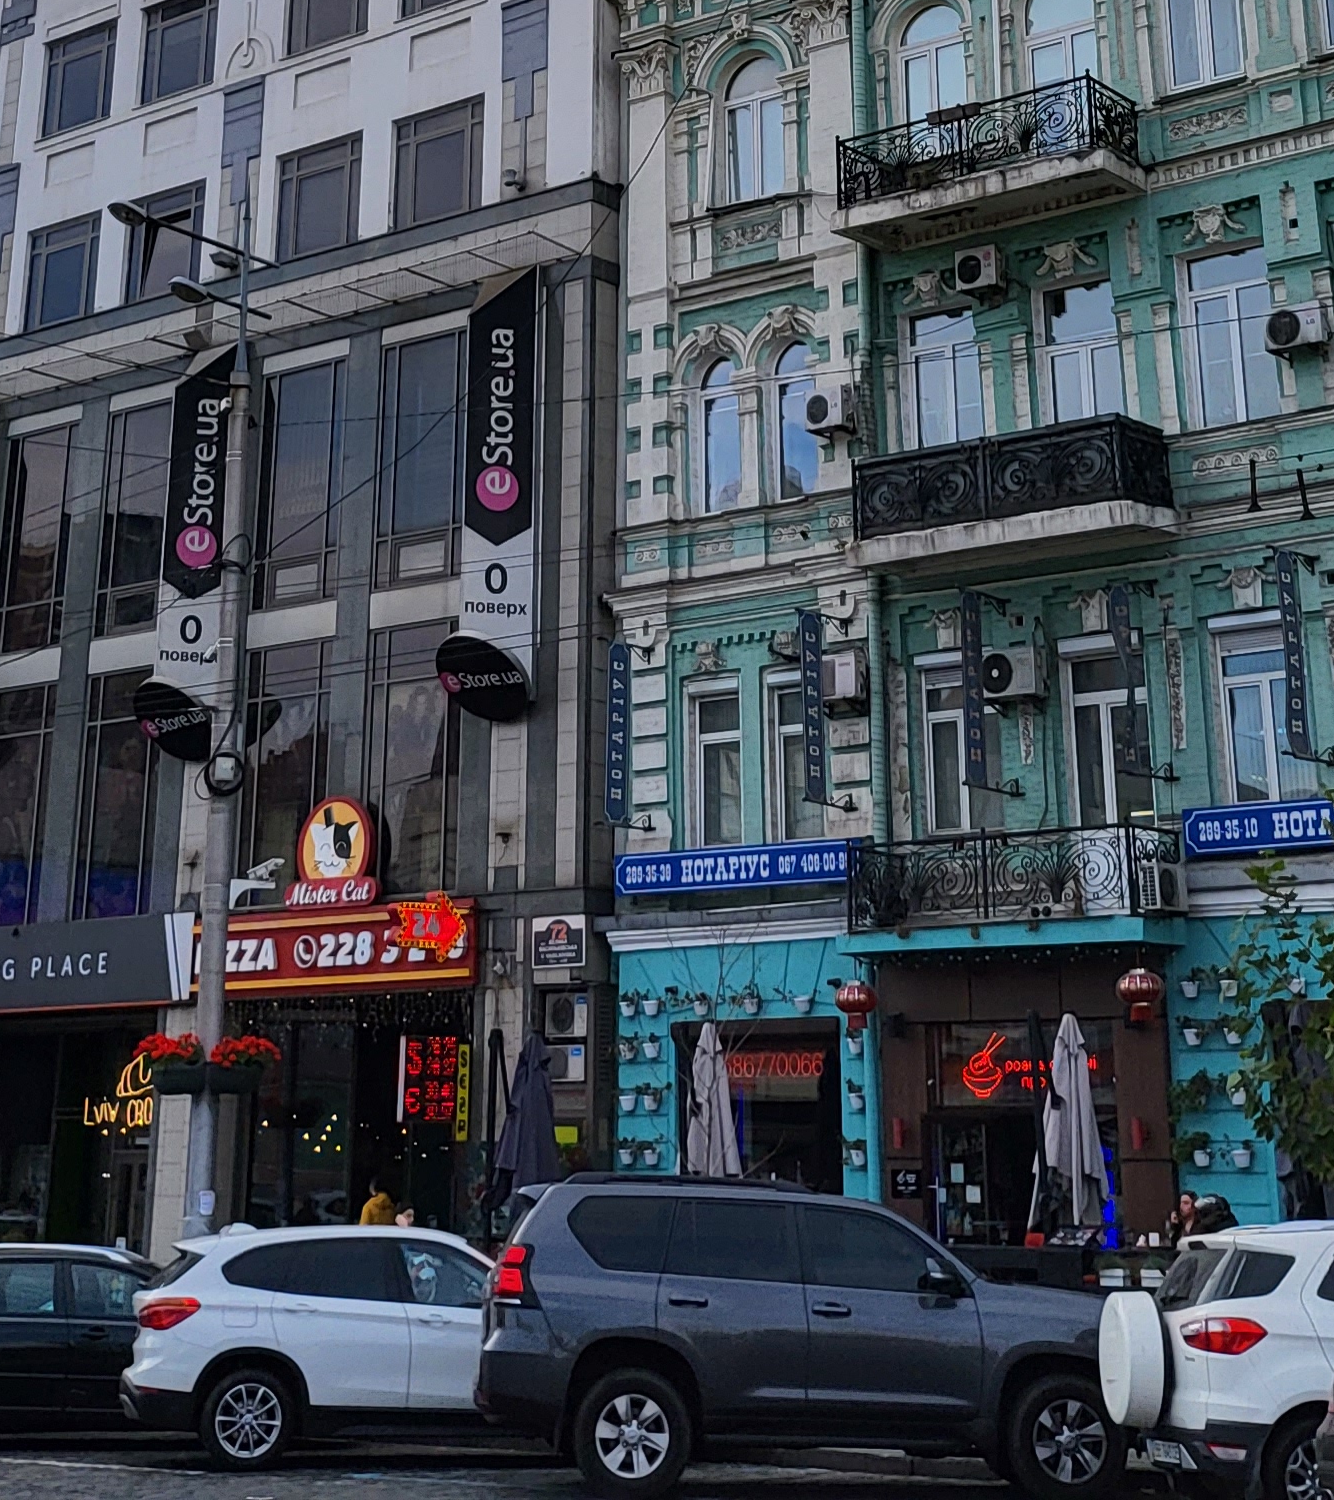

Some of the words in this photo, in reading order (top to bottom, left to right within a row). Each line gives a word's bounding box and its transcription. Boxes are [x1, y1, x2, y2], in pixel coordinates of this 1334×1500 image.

[482, 328, 515, 495] eStore.ua
[183, 398, 220, 552] eStore.ua
[465, 599, 528, 617] поверх
[1280, 570, 1304, 735] НОТАРІУС
[446, 670, 525, 692] eStore.ua
[805, 631, 821, 778] НОТАРІУС
[147, 708, 208, 736] eStore.ua
[610, 661, 625, 800] НОТАРІУС
[1198, 816, 1259, 843] 289-35-10
[680, 853, 770, 884] НОТАРІУС
[778, 854, 797, 875] 067
[800, 851, 847, 874] 408-00-9
[285, 882, 338, 906] Mister
[341, 879, 370, 902] Cat
[548, 923, 569, 940] 72
[317, 930, 376, 969] 228
[30, 951, 109, 980] PLACE
[83, 1096, 120, 1127] Lviv
